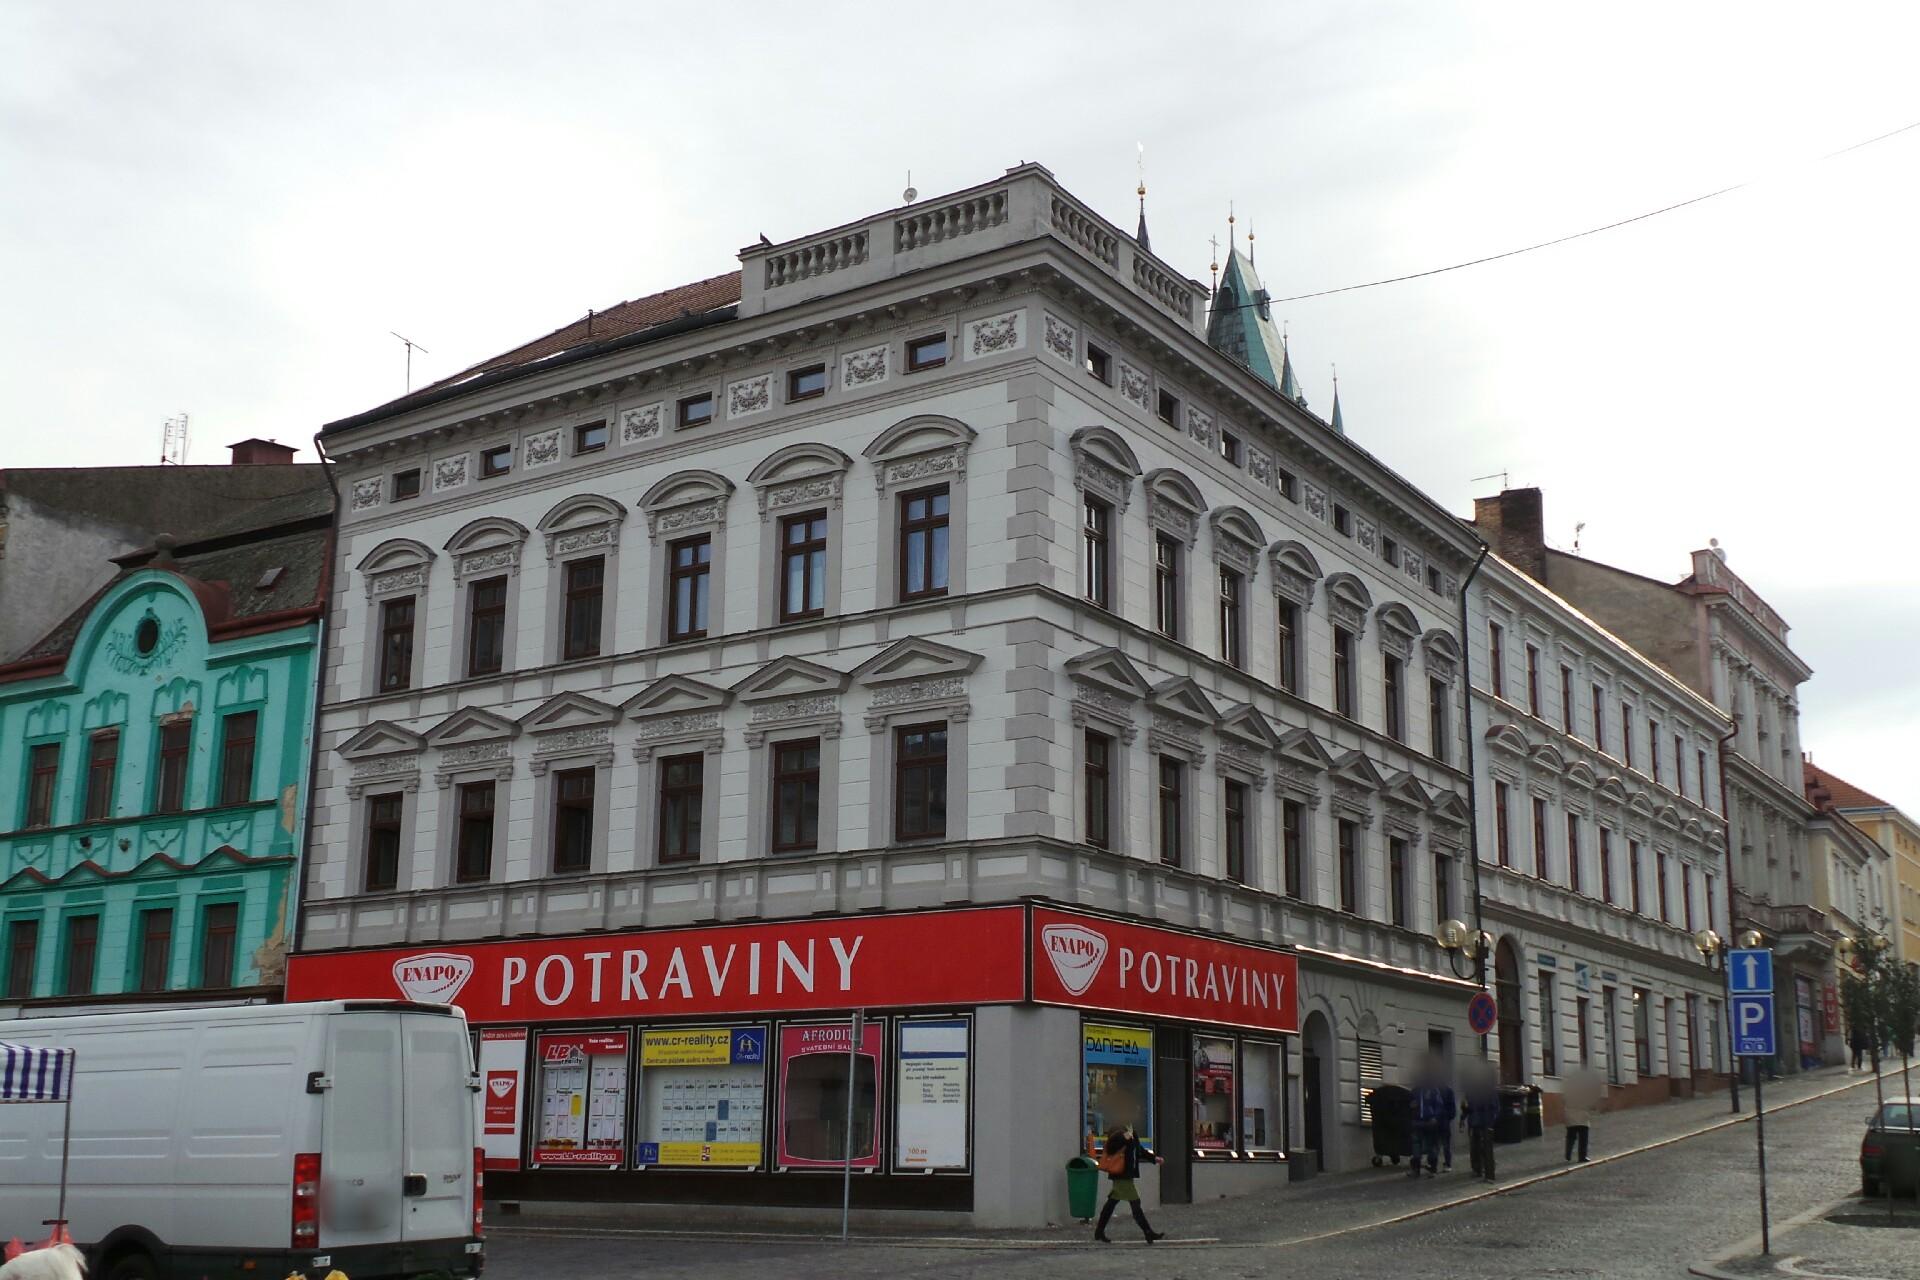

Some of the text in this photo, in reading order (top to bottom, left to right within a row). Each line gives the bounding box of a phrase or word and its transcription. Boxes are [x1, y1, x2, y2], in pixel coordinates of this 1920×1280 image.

[1051, 935, 1094, 957] ENAPO
[402, 964, 456, 982] ENAPO
[501, 935, 864, 1006] POTRAVINY
[1119, 947, 1285, 1010] POTRAVINY
[1740, 1002, 1764, 1036] P
[645, 1033, 729, 1048] www.cr-reality.cz
[802, 1029, 853, 1041] AFRODIT
